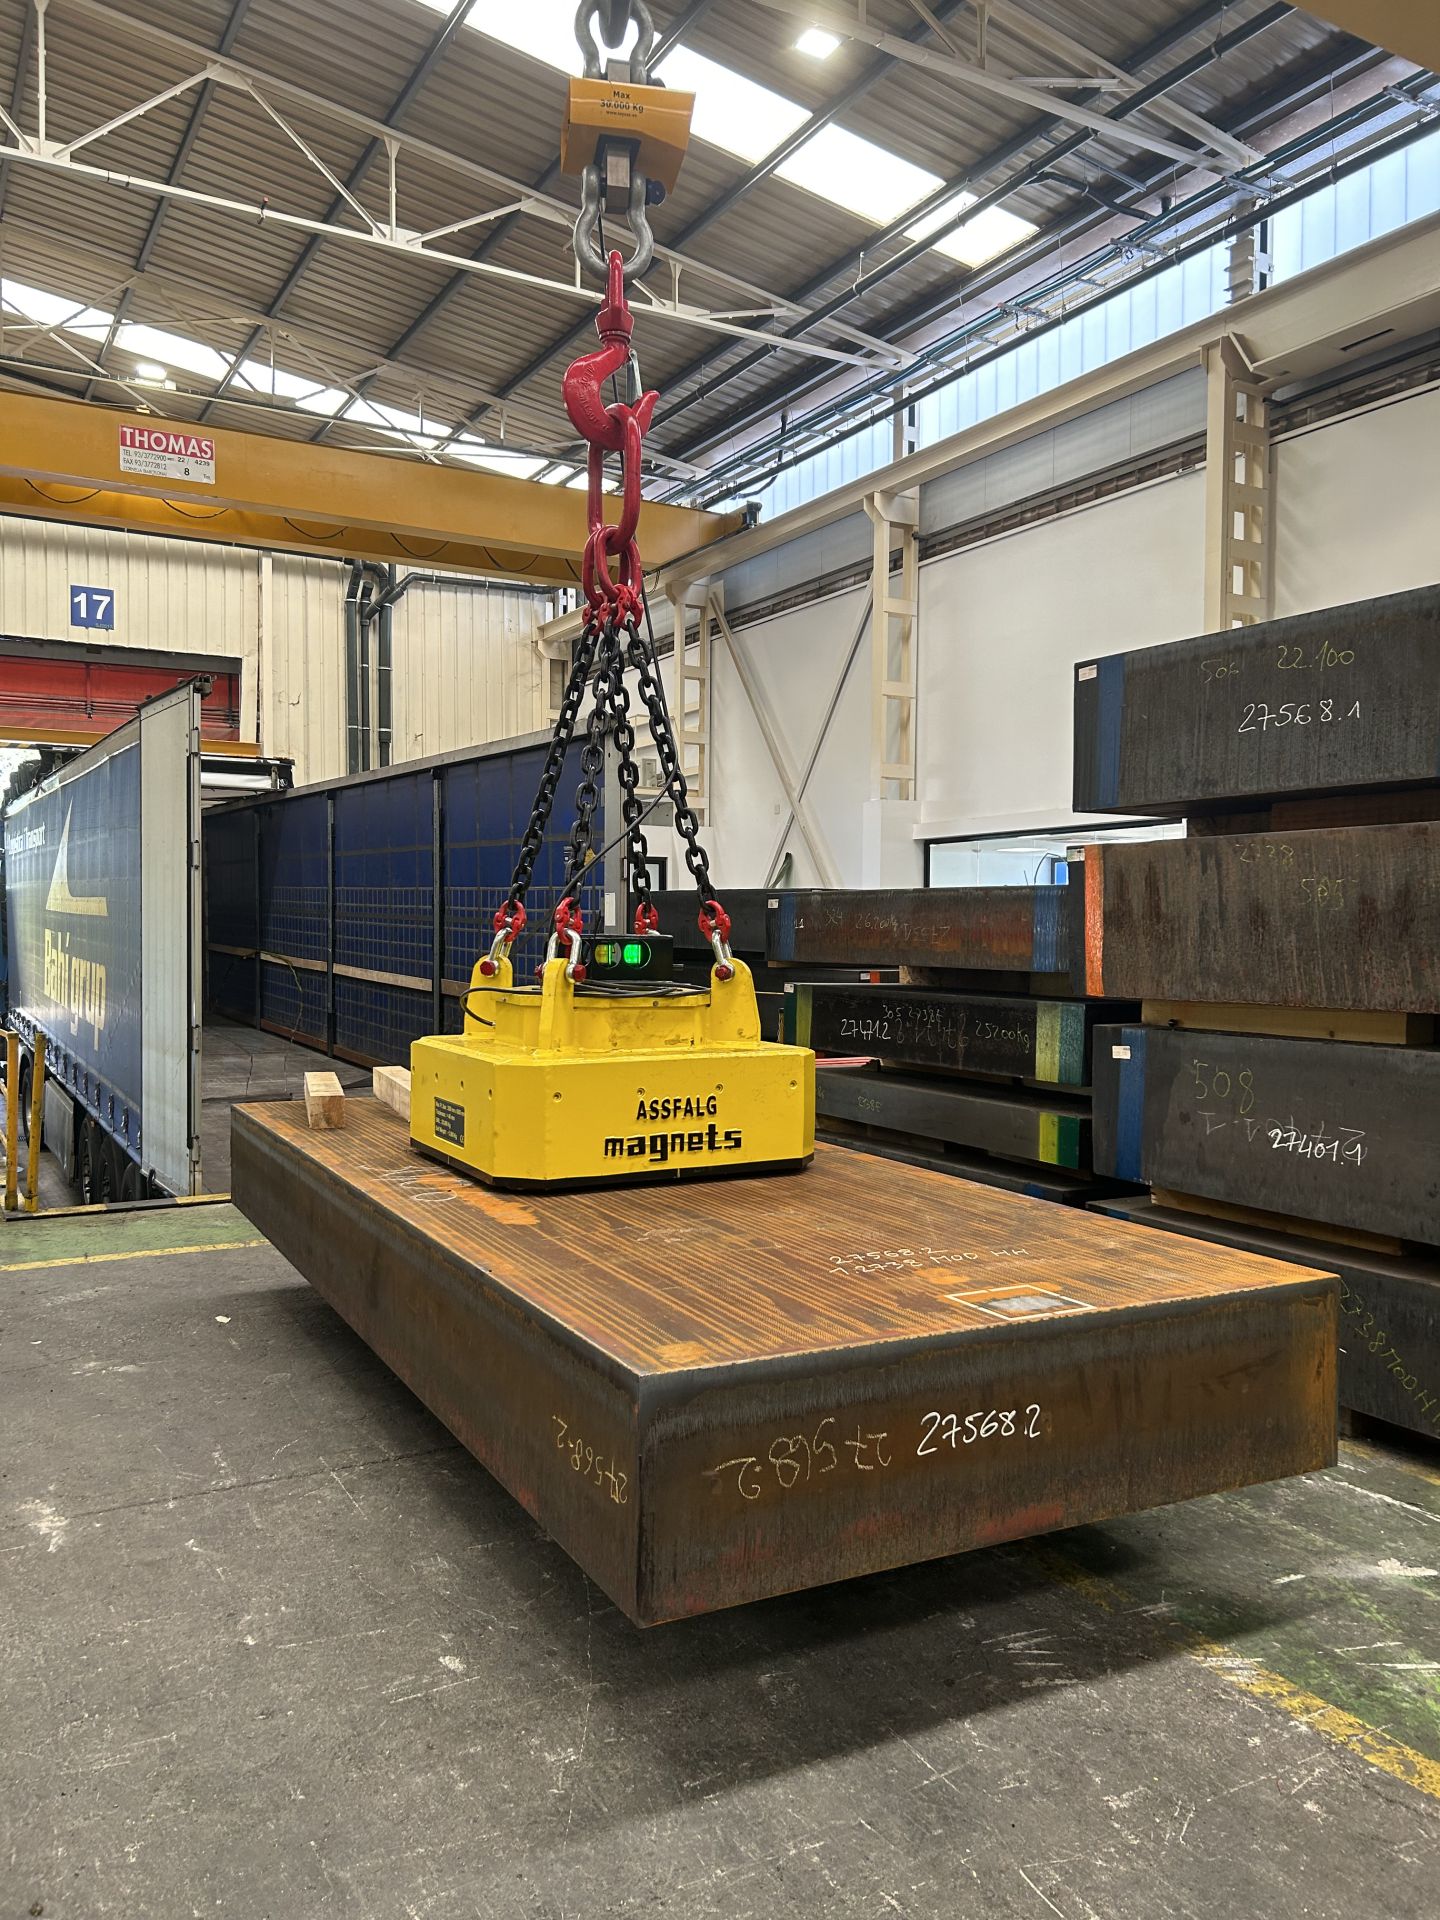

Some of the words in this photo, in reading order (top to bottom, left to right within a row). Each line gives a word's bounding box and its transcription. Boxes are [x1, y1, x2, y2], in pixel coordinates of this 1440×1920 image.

[600, 99, 630, 110] 30.000
[632, 103, 644, 113] Kg
[613, 90, 630, 99] Max
[122, 427, 212, 459] THOMAS
[184, 467, 190, 476] 8
[74, 593, 110, 620] 17
[1238, 698, 1361, 733] 27568.1
[1194, 1060, 1254, 1114] 508
[636, 1095, 718, 1121] ASSFALG
[603, 1123, 743, 1163] magnets
[1268, 1128, 1361, 1166] 27401.1
[916, 1403, 1041, 1457] 27568.2
